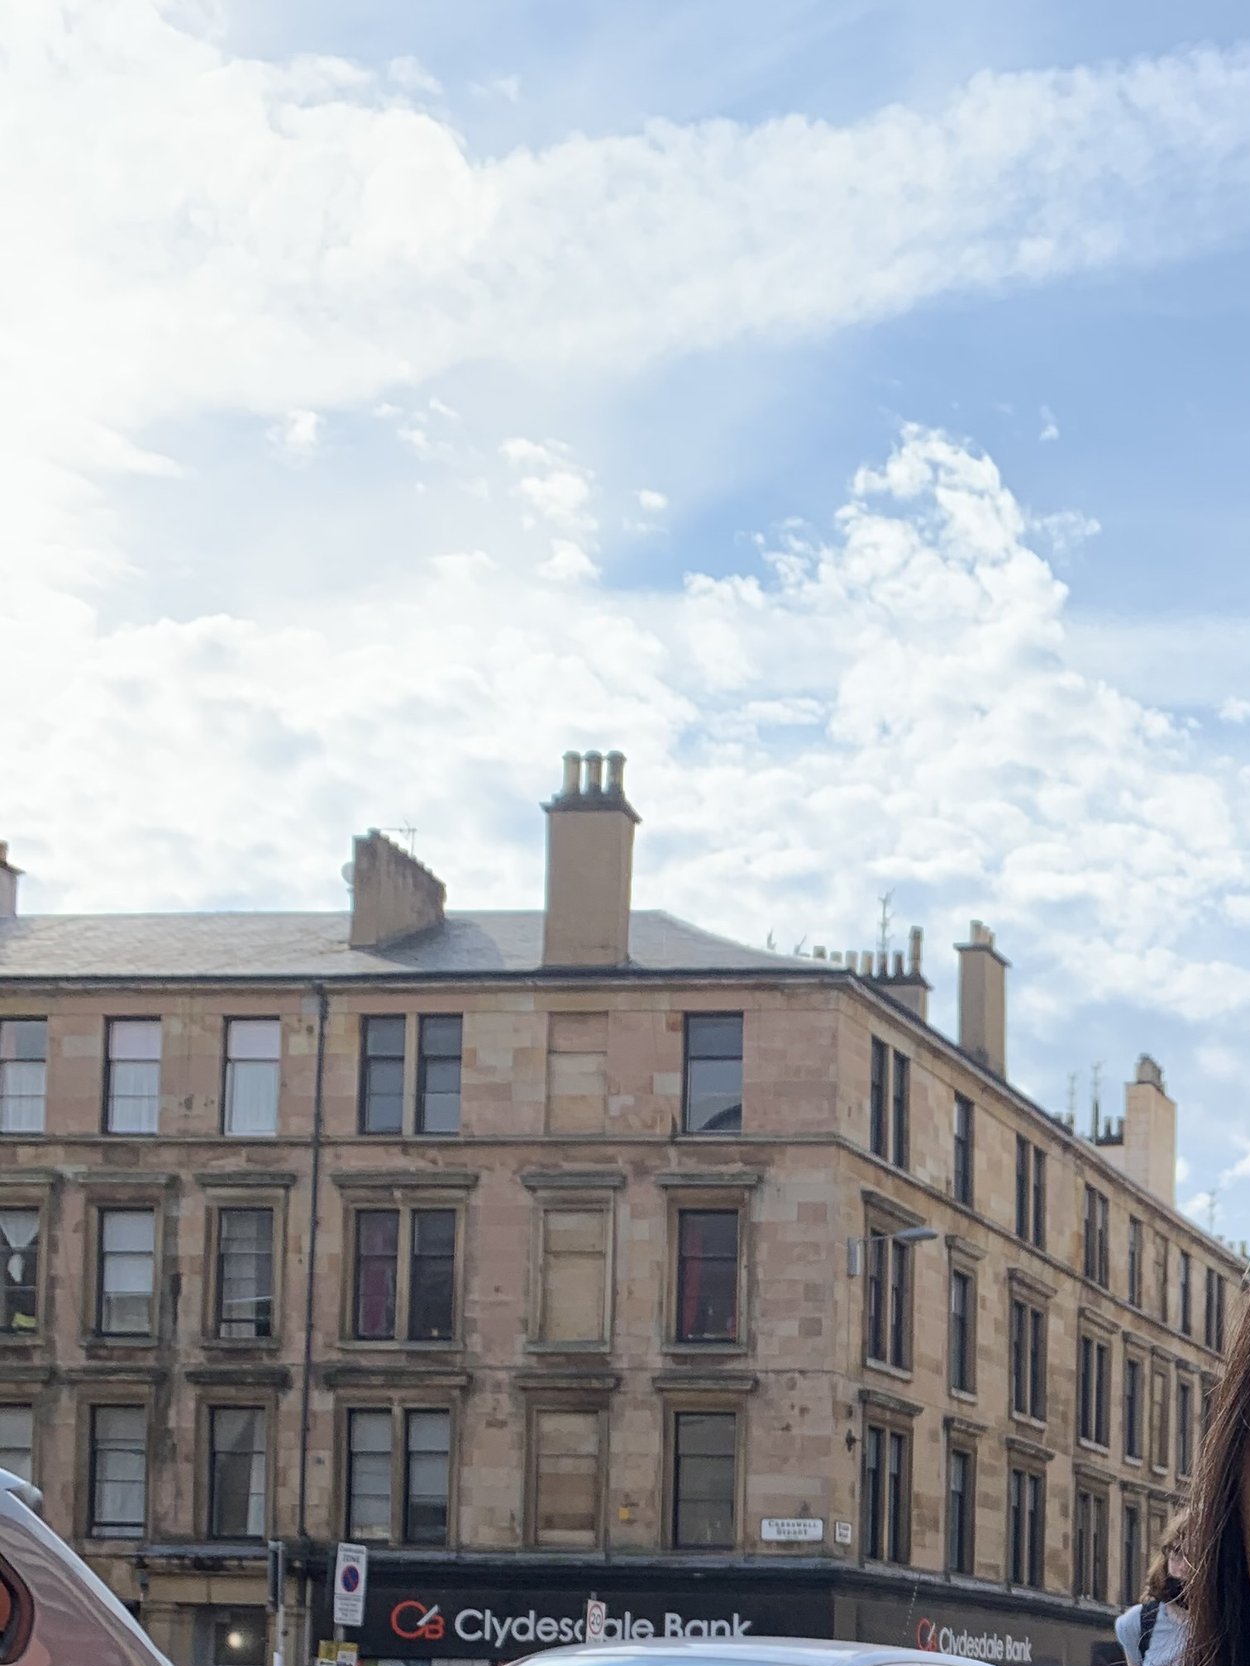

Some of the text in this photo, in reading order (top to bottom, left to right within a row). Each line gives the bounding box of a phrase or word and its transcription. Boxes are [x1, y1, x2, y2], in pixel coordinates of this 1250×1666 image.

[591, 1612, 601, 1626] 20
[664, 1611, 753, 1638] Bank
[940, 1626, 1004, 1660] Clydesdale
[1006, 1634, 1032, 1662] Bank
